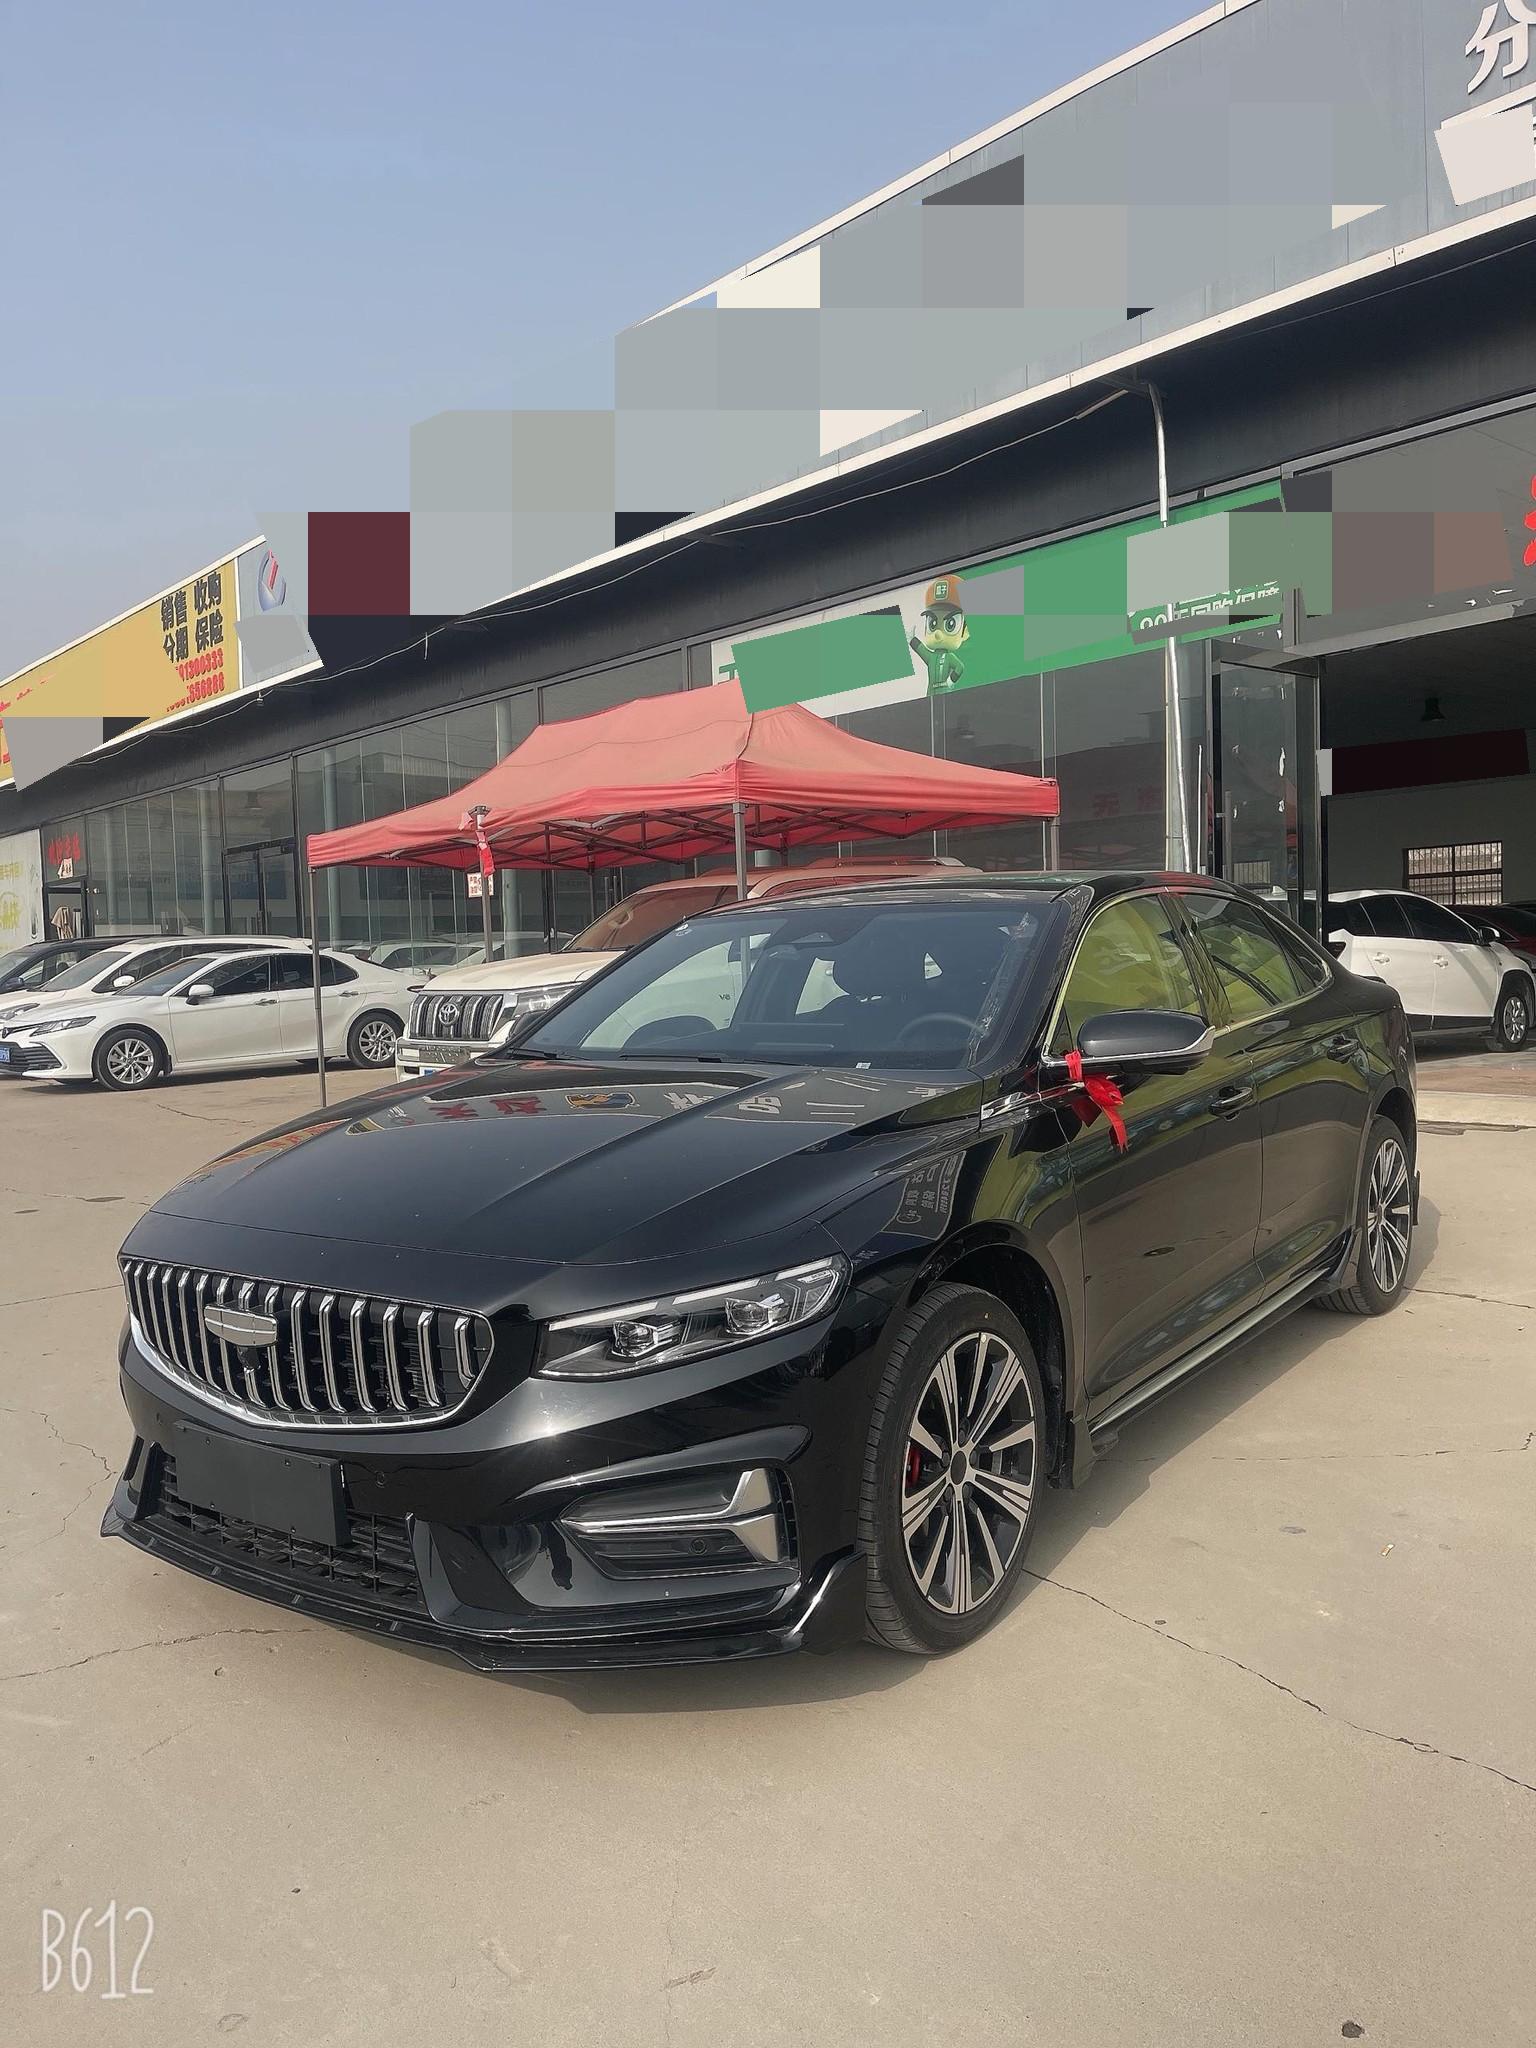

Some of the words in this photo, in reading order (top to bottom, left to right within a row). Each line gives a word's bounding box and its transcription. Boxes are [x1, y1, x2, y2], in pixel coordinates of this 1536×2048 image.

[160, 590, 188, 632] 销售
[193, 571, 222, 616] 收购
[195, 608, 224, 653] 保险
